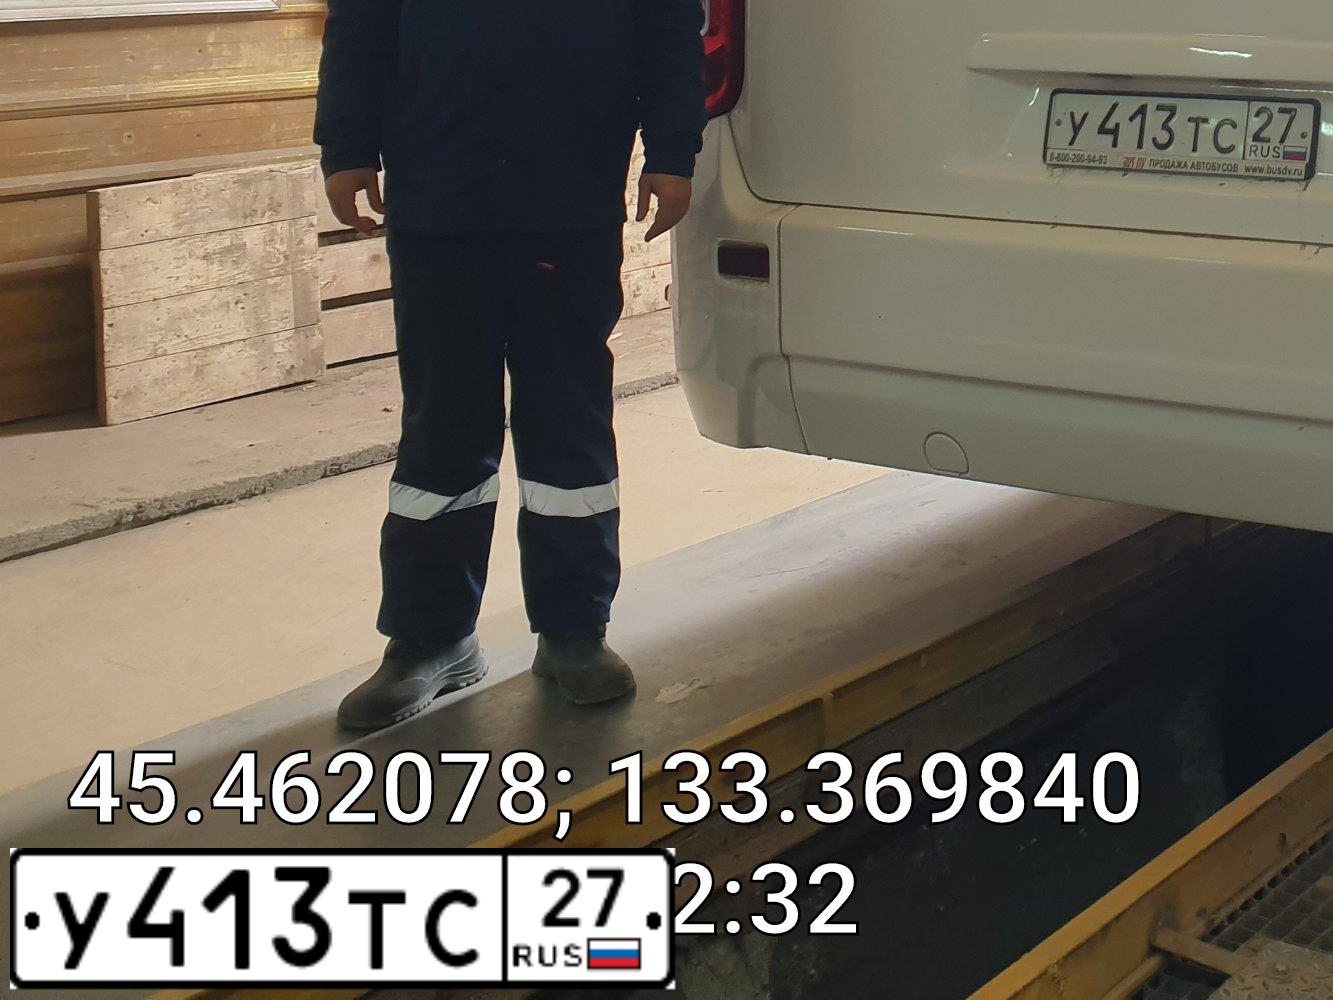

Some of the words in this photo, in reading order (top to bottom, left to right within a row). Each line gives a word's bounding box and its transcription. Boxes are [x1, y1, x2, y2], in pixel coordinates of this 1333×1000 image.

[1251, 106, 1297, 146] 27
[1248, 144, 1281, 159] RUS
[1149, 158, 1188, 170] ПРОДАЖА
[1190, 160, 1239, 173] АВТОБУСОВ
[1244, 164, 1303, 177] www.busdv.ru
